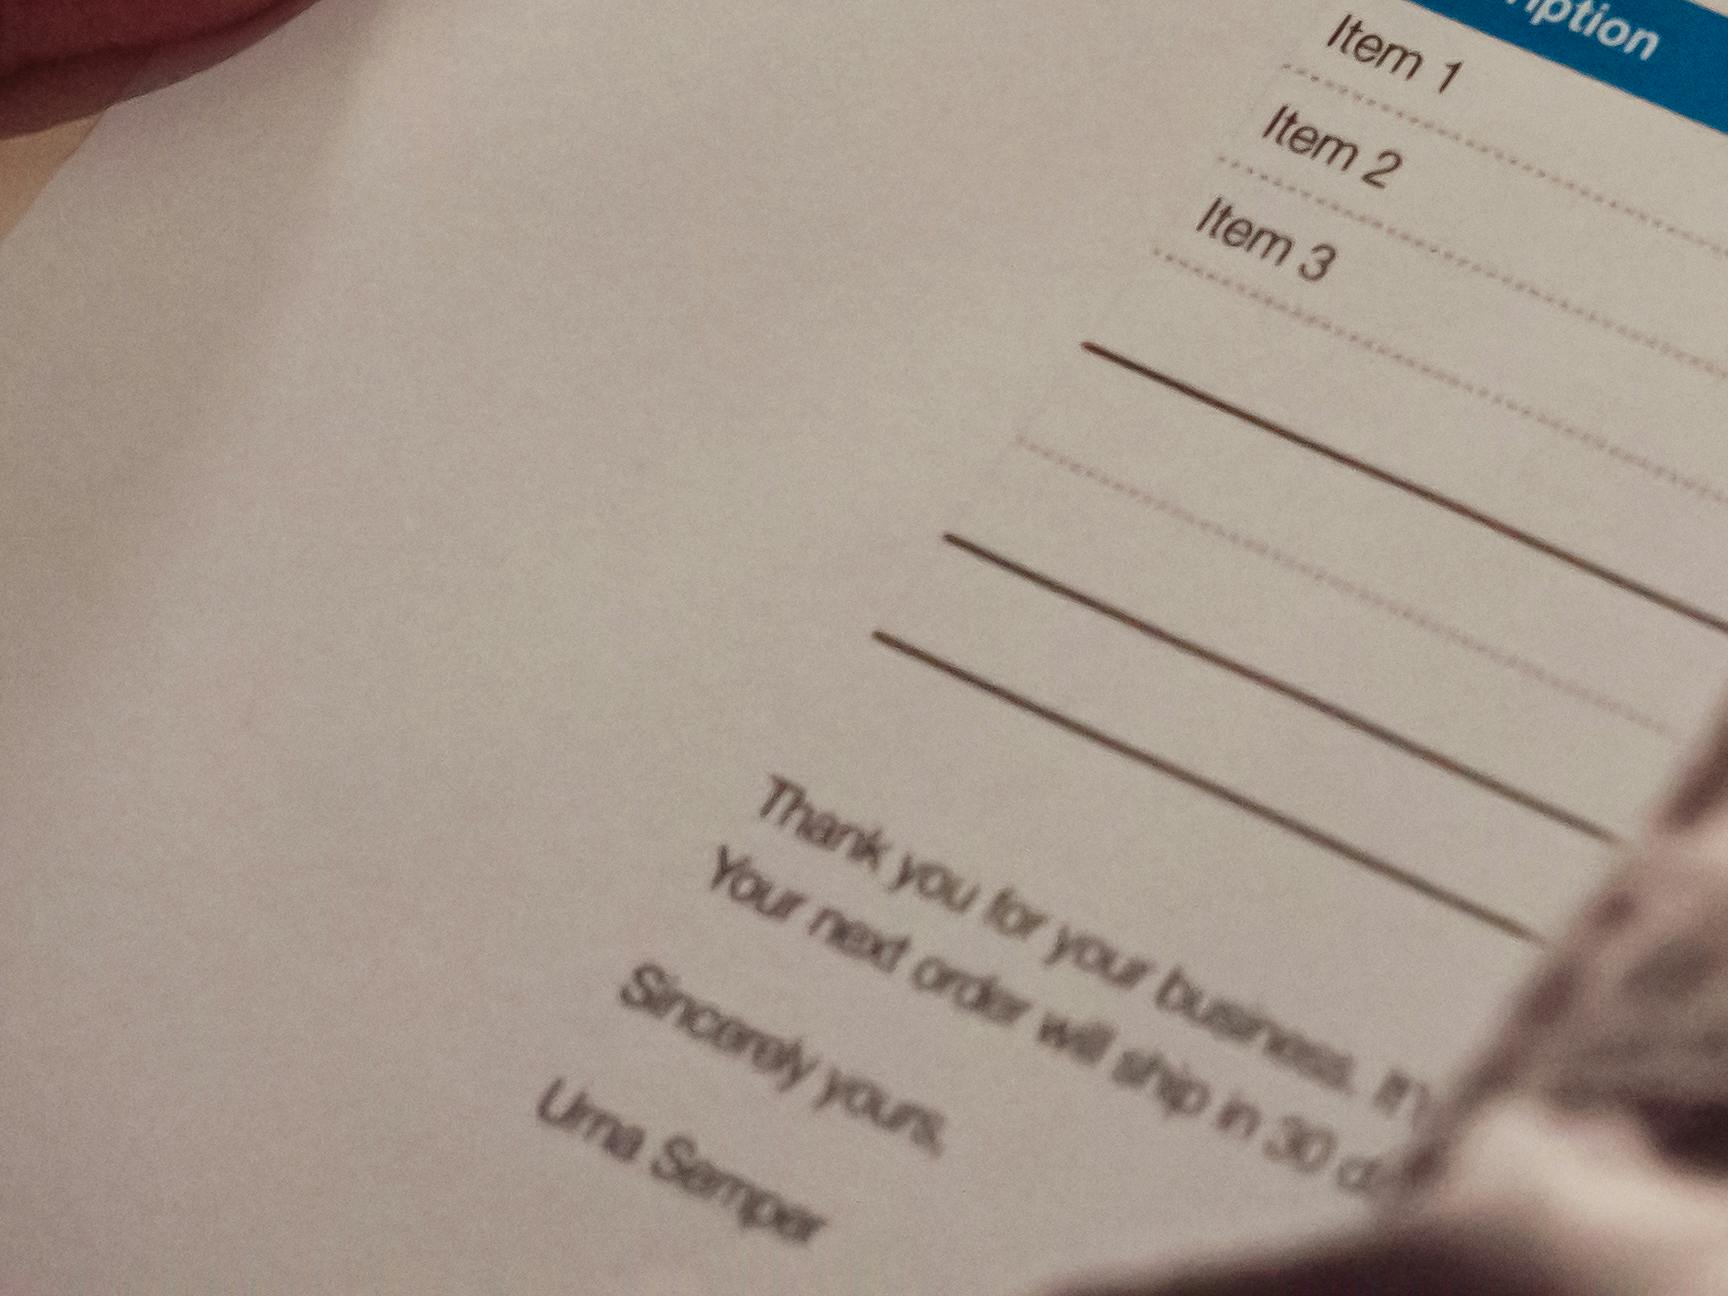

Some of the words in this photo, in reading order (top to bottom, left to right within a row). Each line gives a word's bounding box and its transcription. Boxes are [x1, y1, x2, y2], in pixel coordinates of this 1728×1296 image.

[1327, 13, 1431, 83] Item
[1436, 61, 1464, 94] 1
[1262, 105, 1359, 174] Item
[1362, 152, 1403, 190] 2
[1197, 197, 1296, 268] Item
[1297, 244, 1337, 284] 3
[759, 773, 890, 872] Thank
[888, 854, 980, 915] you
[985, 887, 1049, 941] for
[1043, 925, 1156, 990] your
[619, 961, 822, 1092] Sincerely
[710, 844, 803, 923] Your
[808, 907, 911, 973] next
[911, 956, 1032, 1026] order
[1216, 1092, 1260, 1140] in
[1263, 1116, 1337, 1174] 30
